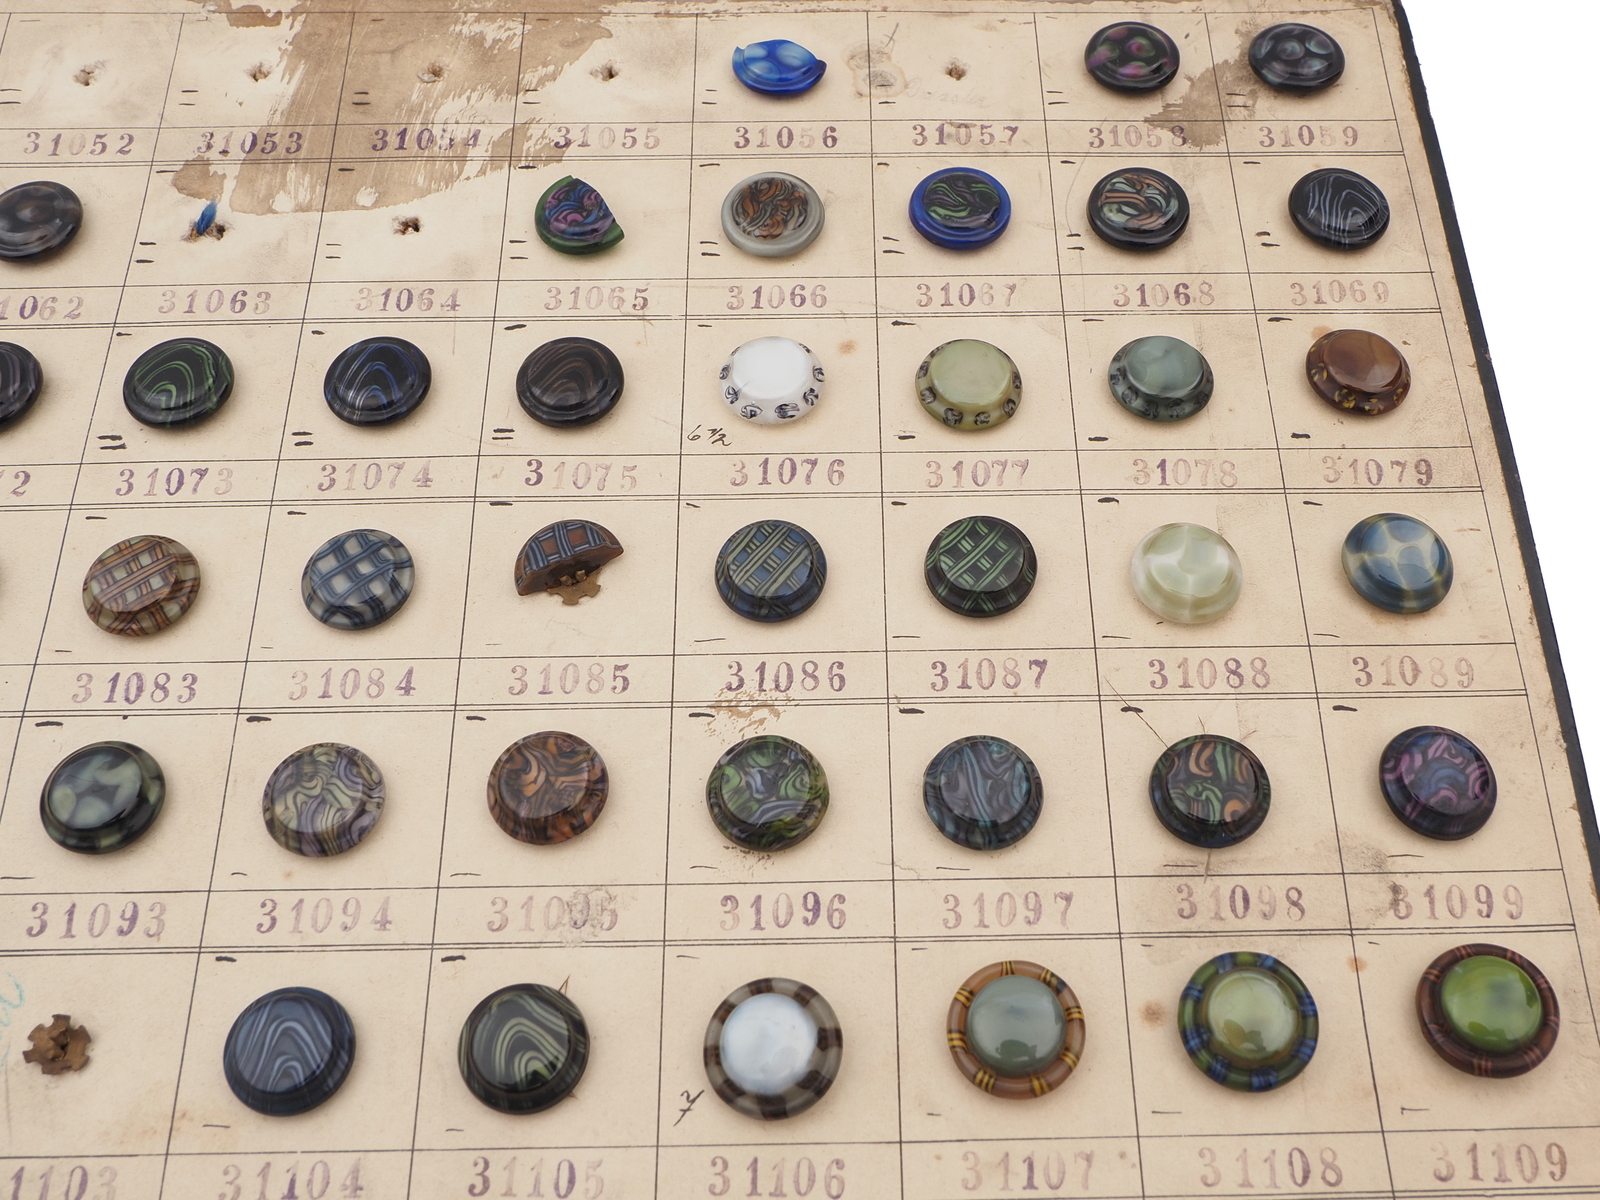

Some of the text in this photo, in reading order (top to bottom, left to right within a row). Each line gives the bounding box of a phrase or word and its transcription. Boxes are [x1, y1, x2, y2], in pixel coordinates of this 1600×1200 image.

[20, 129, 134, 157] 31052
[196, 129, 306, 157] 31053
[550, 124, 660, 151] 31055
[730, 122, 839, 149] 31056
[912, 121, 1022, 148] 31057
[1089, 122, 1190, 149] 31058
[1259, 125, 1358, 148] 31059
[158, 289, 271, 314] 31063
[357, 287, 461, 312] 31064
[544, 286, 649, 313] 31065
[726, 284, 827, 310] 31066
[917, 282, 1017, 307] 31067
[1113, 280, 1215, 307] 31068
[1290, 281, 1391, 308] 31069
[115, 467, 233, 496] 31073
[317, 460, 433, 492] 31074
[523, 458, 637, 491] 31075
[730, 457, 845, 487] 31076
[926, 459, 1029, 488] 31077
[1134, 459, 1240, 488] 31078
[1323, 455, 1435, 485] 31079
[289, 666, 416, 701] 31084
[508, 663, 630, 696] 31085
[722, 660, 846, 695] 31086
[930, 657, 1048, 692] 31087
[1148, 657, 1271, 691] 31088
[1352, 655, 1474, 689] 31089
[71, 672, 198, 705] 31083
[256, 897, 392, 934] 31094
[720, 892, 846, 931] 31096
[943, 891, 1074, 930] 31097
[1176, 883, 1306, 922] 31098
[1392, 882, 1523, 920] 31099
[26, 901, 166, 940] 31093
[467, 1157, 604, 1199] 31105
[708, 1156, 845, 1200] 31106
[962, 1151, 1094, 1191] 31107
[1198, 1147, 1343, 1189] 31108
[1433, 1142, 1568, 1184] 31109
[221, 1162, 365, 1200] 31104
